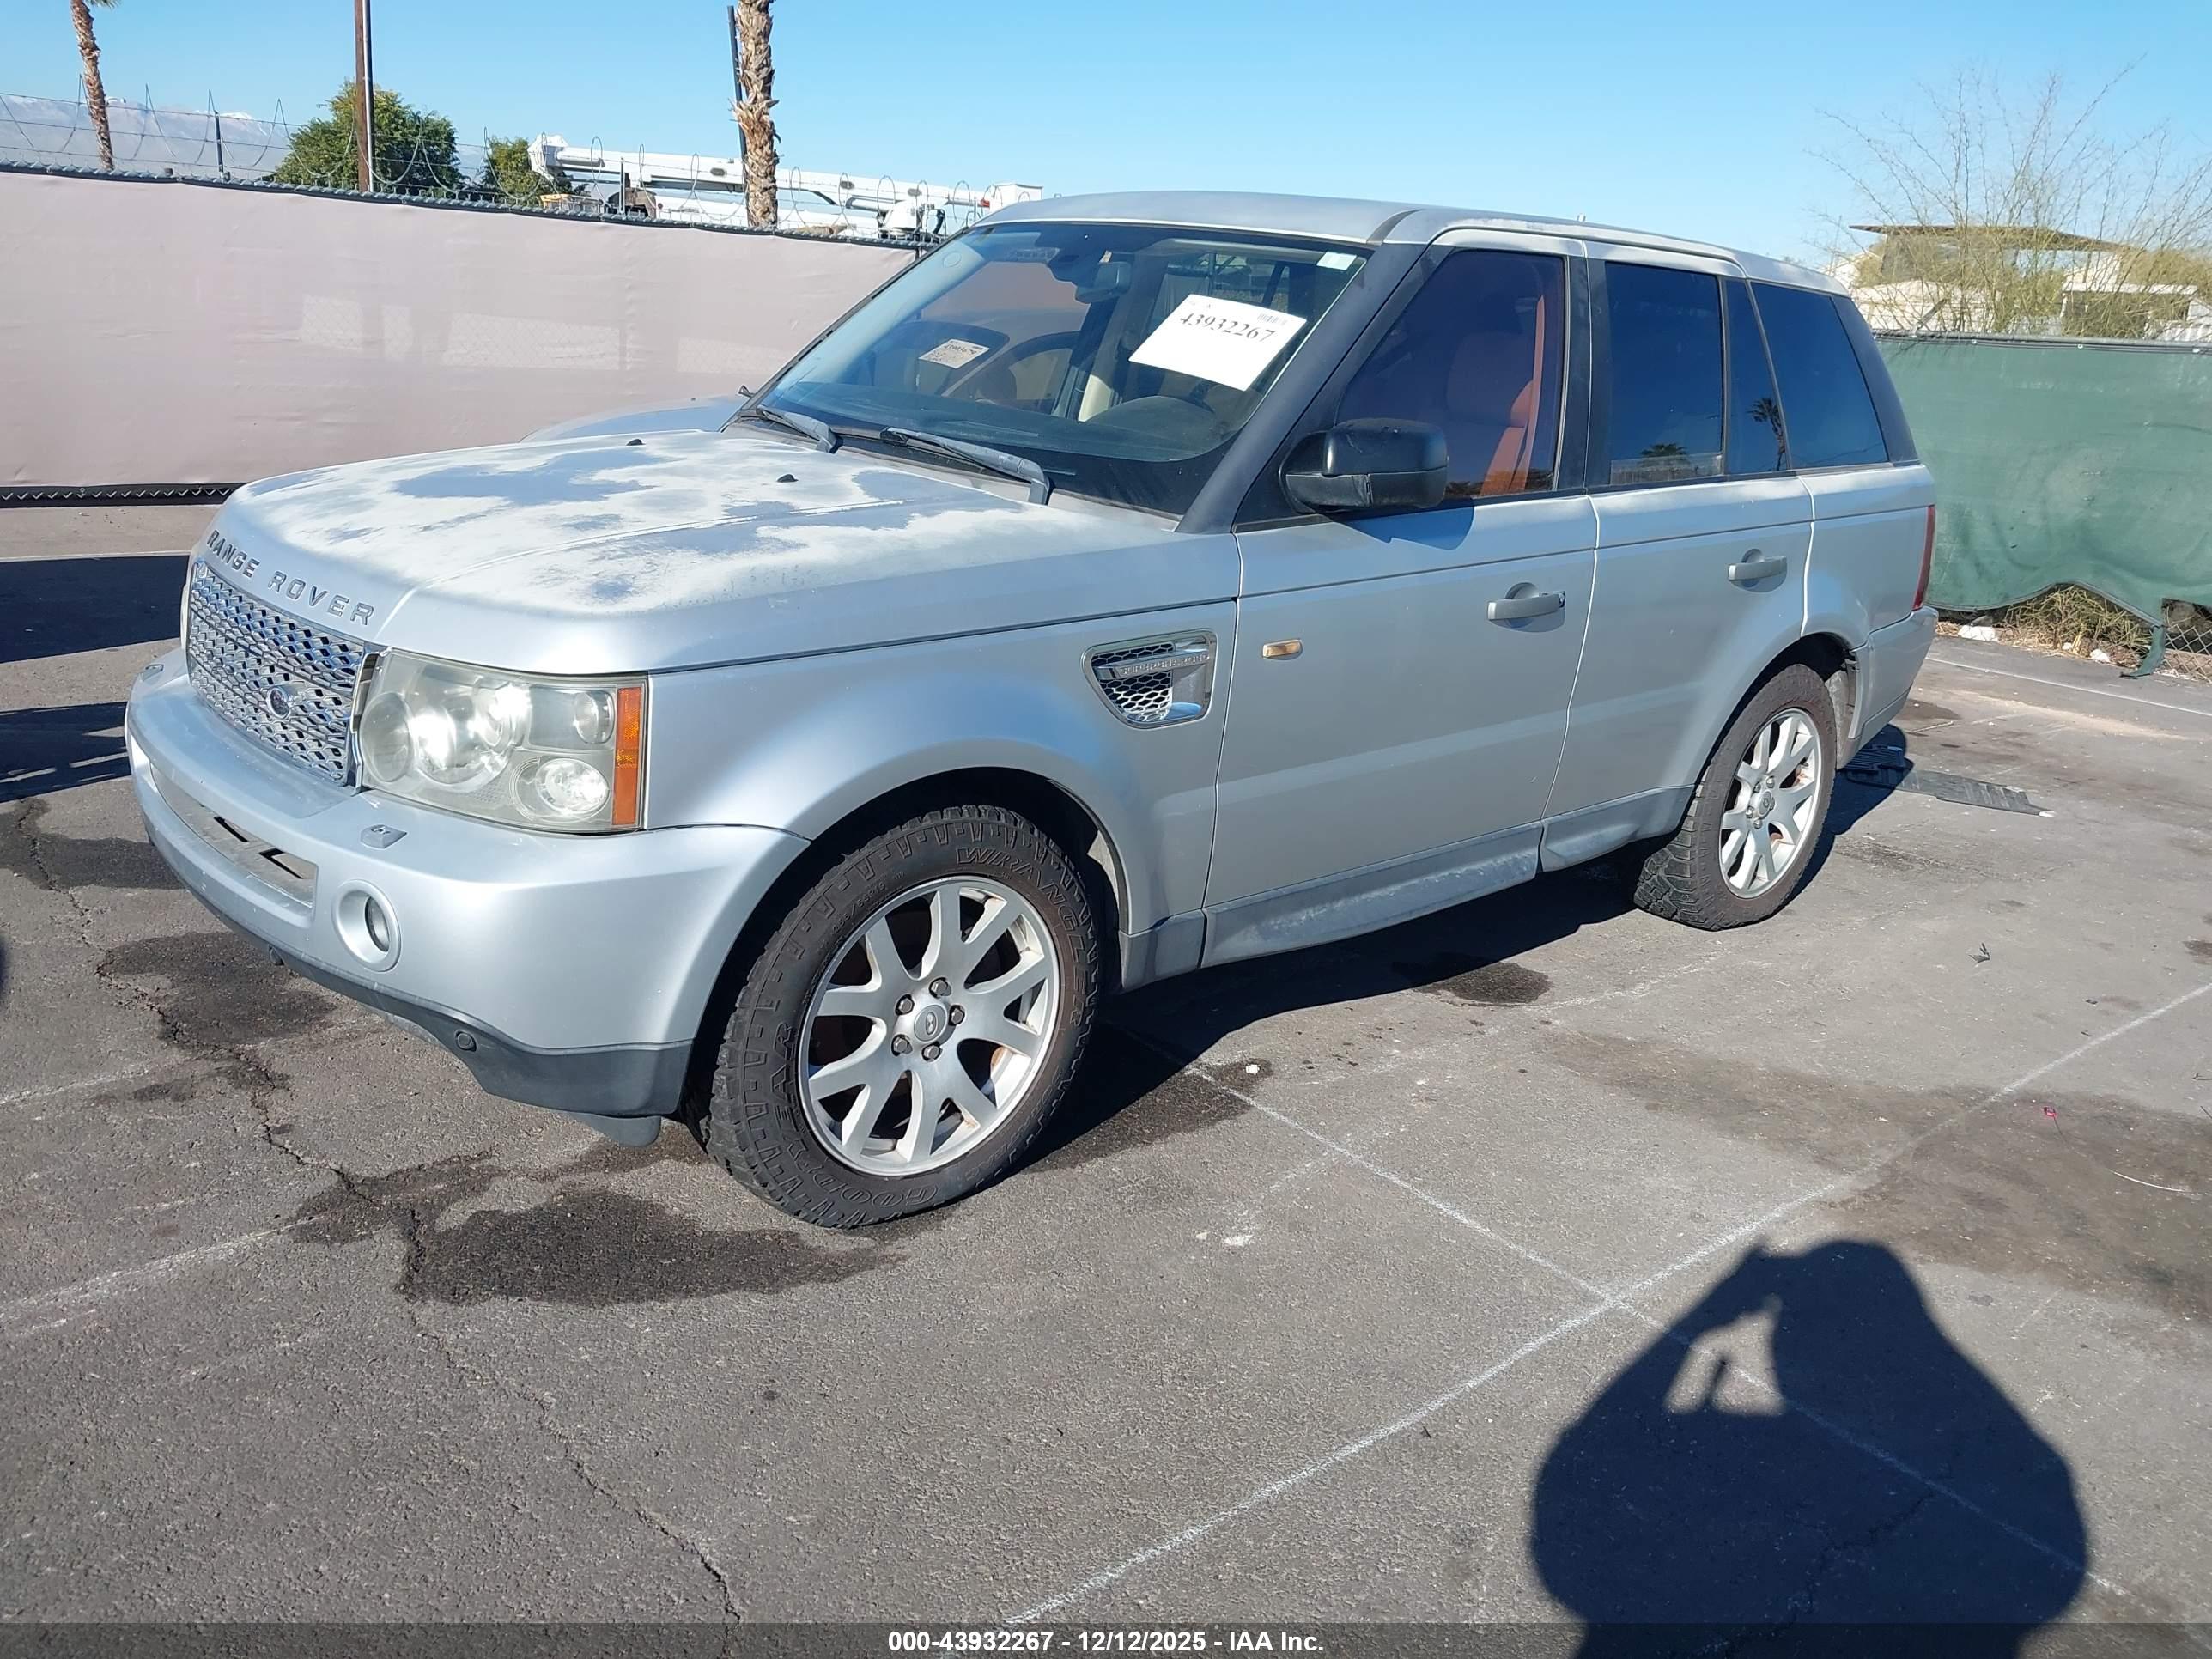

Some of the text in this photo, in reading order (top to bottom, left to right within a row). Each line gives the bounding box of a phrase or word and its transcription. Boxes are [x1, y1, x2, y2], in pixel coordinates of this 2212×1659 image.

[1180, 312, 1276, 343] 43932267
[206, 529, 375, 626] RANGE ROVER
[955, 845, 1089, 1028] WRANGLER
[769, 1020, 940, 1210] GOODYEAR
